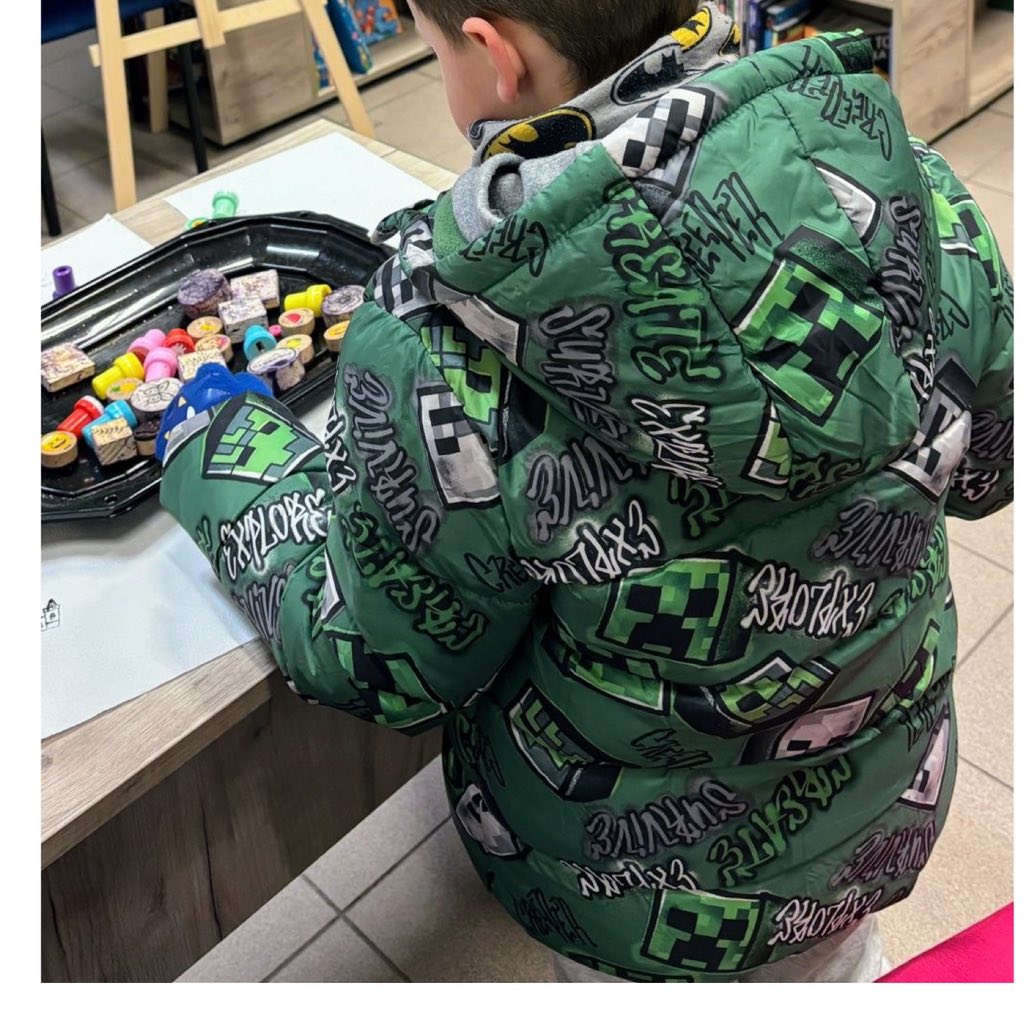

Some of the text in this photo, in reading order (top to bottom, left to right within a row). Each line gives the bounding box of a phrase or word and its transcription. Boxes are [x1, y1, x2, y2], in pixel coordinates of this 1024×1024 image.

[739, 561, 876, 638] EXPLORE
[582, 777, 748, 860] SURVIVE
[767, 885, 884, 947] EXPLORE
